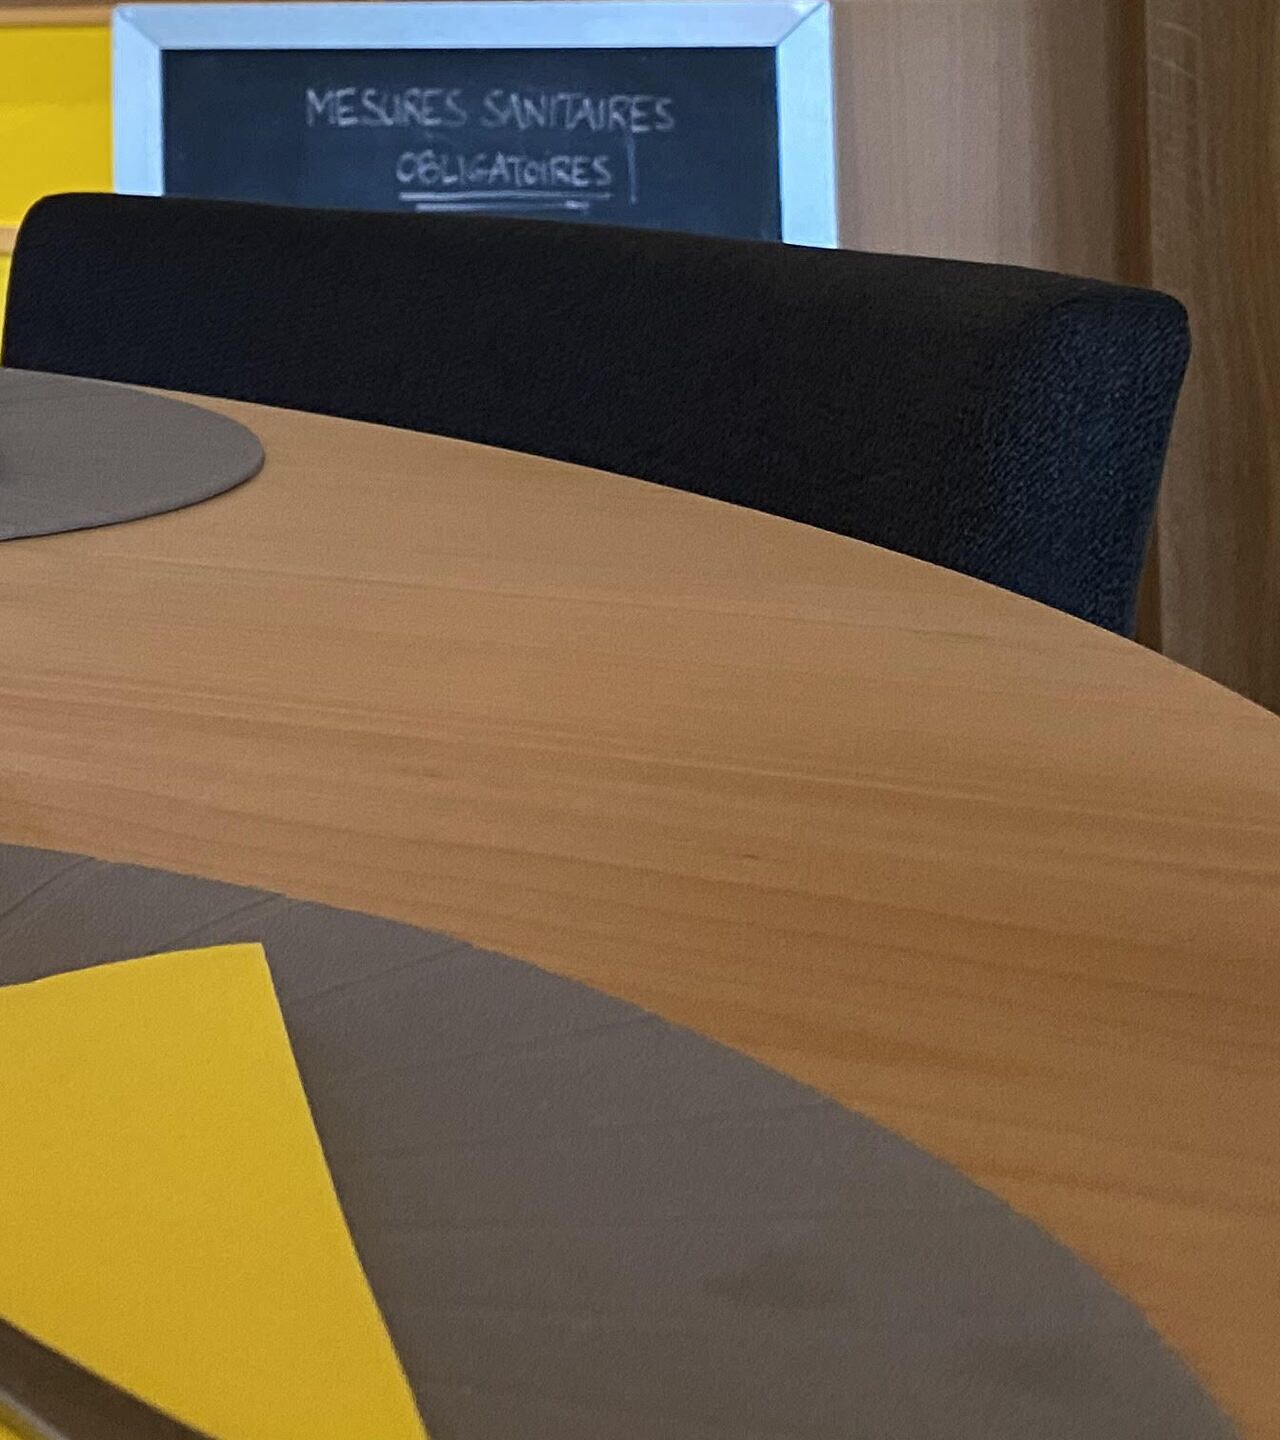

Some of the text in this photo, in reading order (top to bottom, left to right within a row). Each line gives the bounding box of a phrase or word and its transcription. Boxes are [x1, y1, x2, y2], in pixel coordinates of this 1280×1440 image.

[305, 87, 677, 133] MESURES SANITAIRES
[395, 150, 612, 187] OBLIGATOIRES
